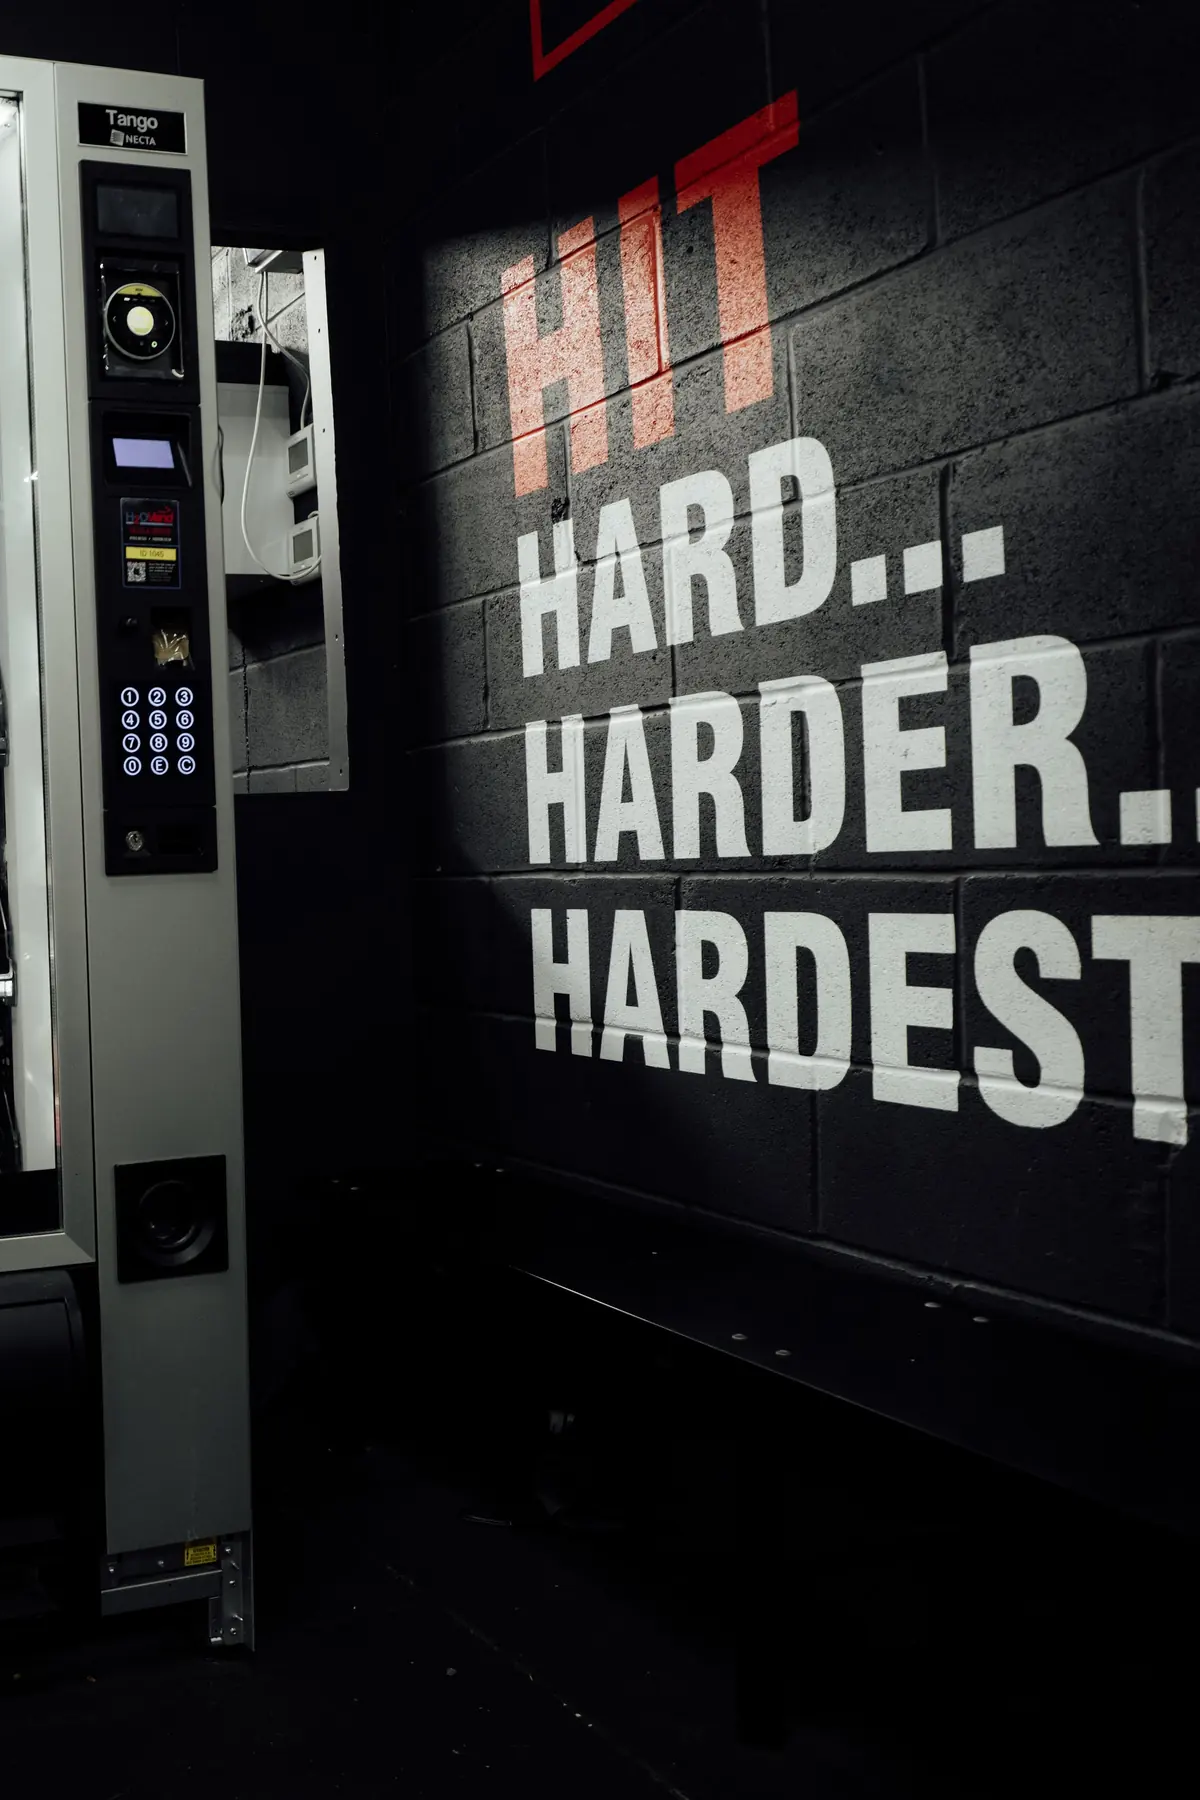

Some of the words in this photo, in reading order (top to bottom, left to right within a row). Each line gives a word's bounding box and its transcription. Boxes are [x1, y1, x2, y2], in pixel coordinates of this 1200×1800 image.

[105, 109, 158, 133] Tango
[125, 134, 157, 146] NECTA
[501, 89, 800, 501] HIT
[517, 436, 1005, 678] HARD...
[126, 690, 132, 703] 1
[152, 690, 162, 703] 2
[179, 690, 189, 703] 3
[125, 713, 135, 726] 4
[153, 713, 163, 726] 5
[180, 713, 190, 726] 6
[127, 736, 136, 749] 7
[154, 736, 164, 749] 8
[181, 736, 191, 749] 9
[525, 634, 1200, 865] HARDER.
[128, 759, 137, 773] 0
[155, 759, 164, 772] E
[181, 758, 192, 772] C
[530, 907, 1200, 1147] HARDEST
